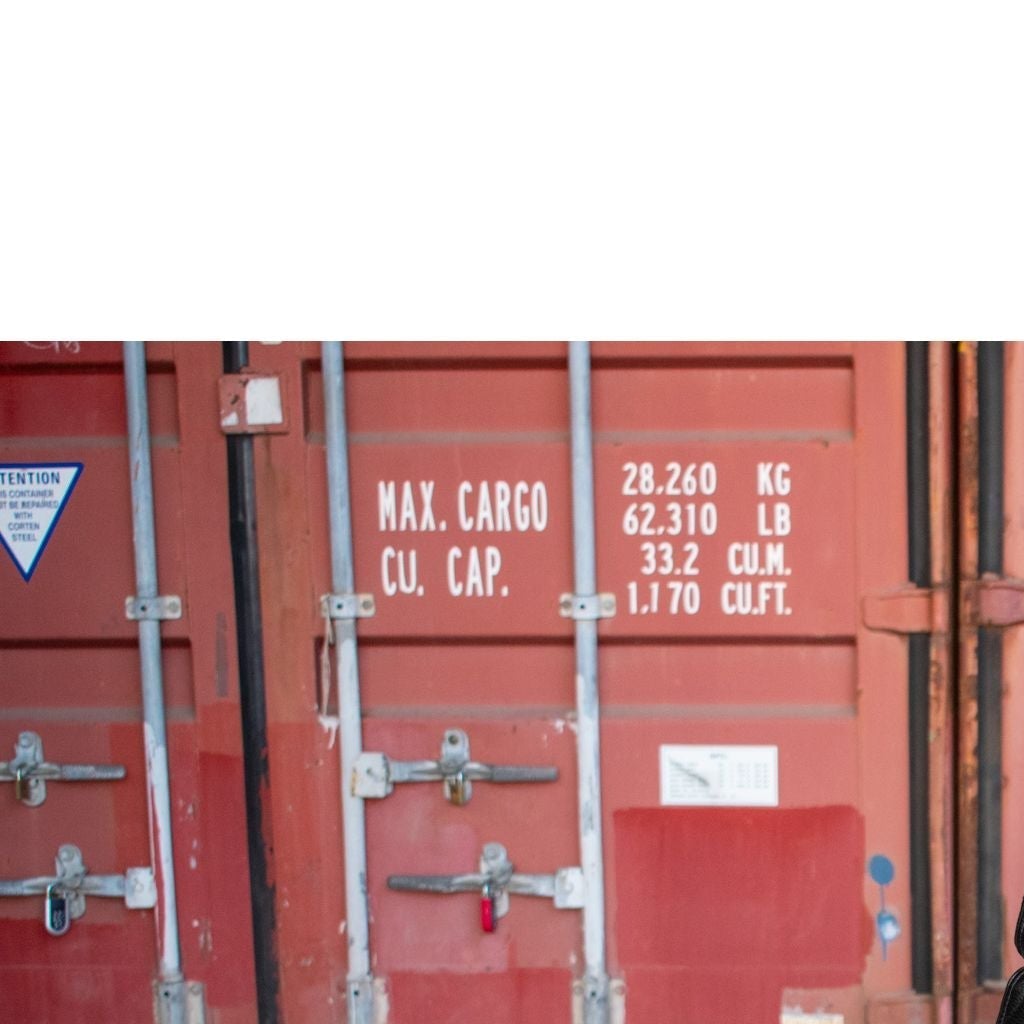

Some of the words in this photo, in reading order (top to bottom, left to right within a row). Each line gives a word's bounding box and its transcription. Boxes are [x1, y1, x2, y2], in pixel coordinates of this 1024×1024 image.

[756, 462, 792, 496] KG
[377, 480, 447, 533] MAX.
[457, 480, 548, 533] CARGO
[757, 501, 792, 537] LB
[381, 545, 425, 597] CU.
[447, 545, 509, 597] CAP.
[640, 541, 700, 576] 33.2
[727, 541, 792, 577] CU.M.
[720, 580, 793, 616] CU.FT.
